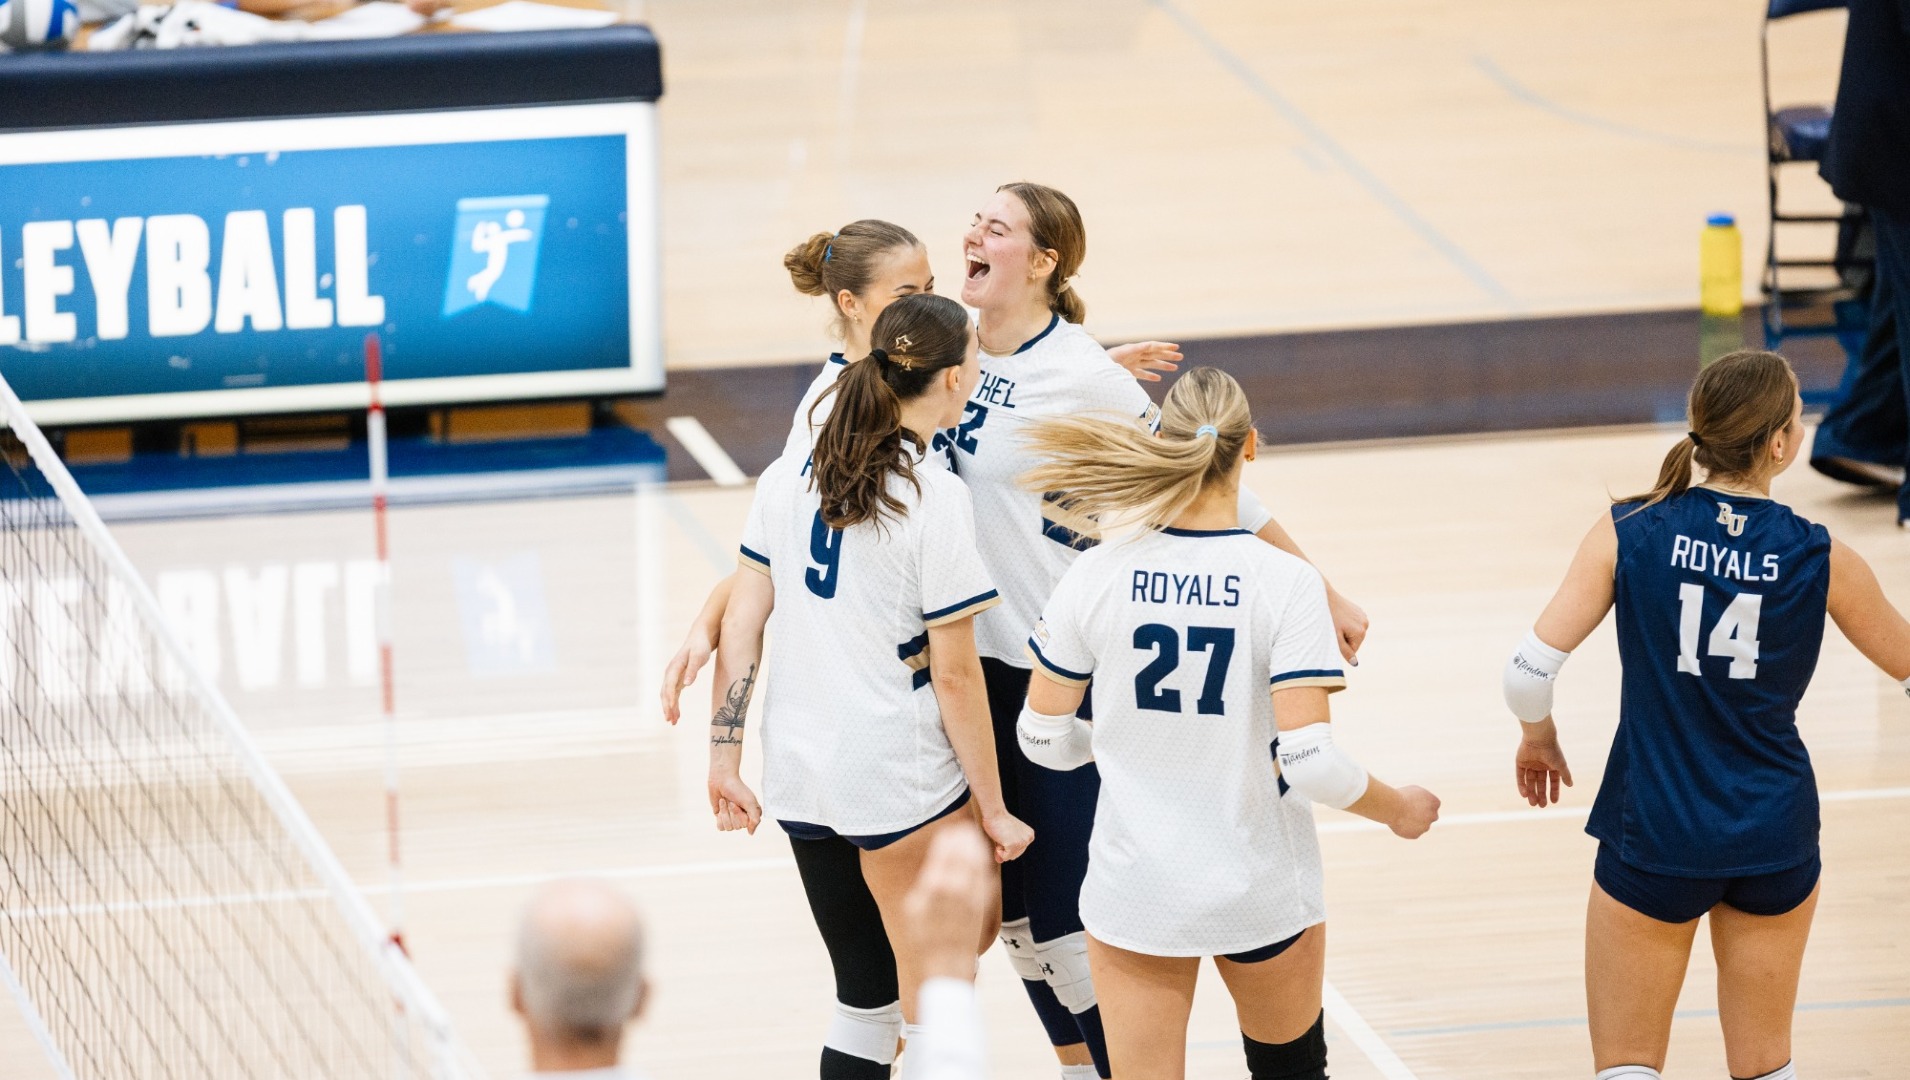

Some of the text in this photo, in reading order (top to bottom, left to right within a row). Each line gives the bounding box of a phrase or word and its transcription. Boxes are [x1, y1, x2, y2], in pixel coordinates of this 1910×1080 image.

[1716, 502, 1748, 537] BU
[805, 507, 844, 599] 9
[1670, 534, 1780, 581] ROYALS
[1132, 569, 1241, 607] ROYALS
[1677, 582, 1763, 679] 14
[1133, 623, 1235, 716] 27
[1517, 652, 1549, 679] Tandem
